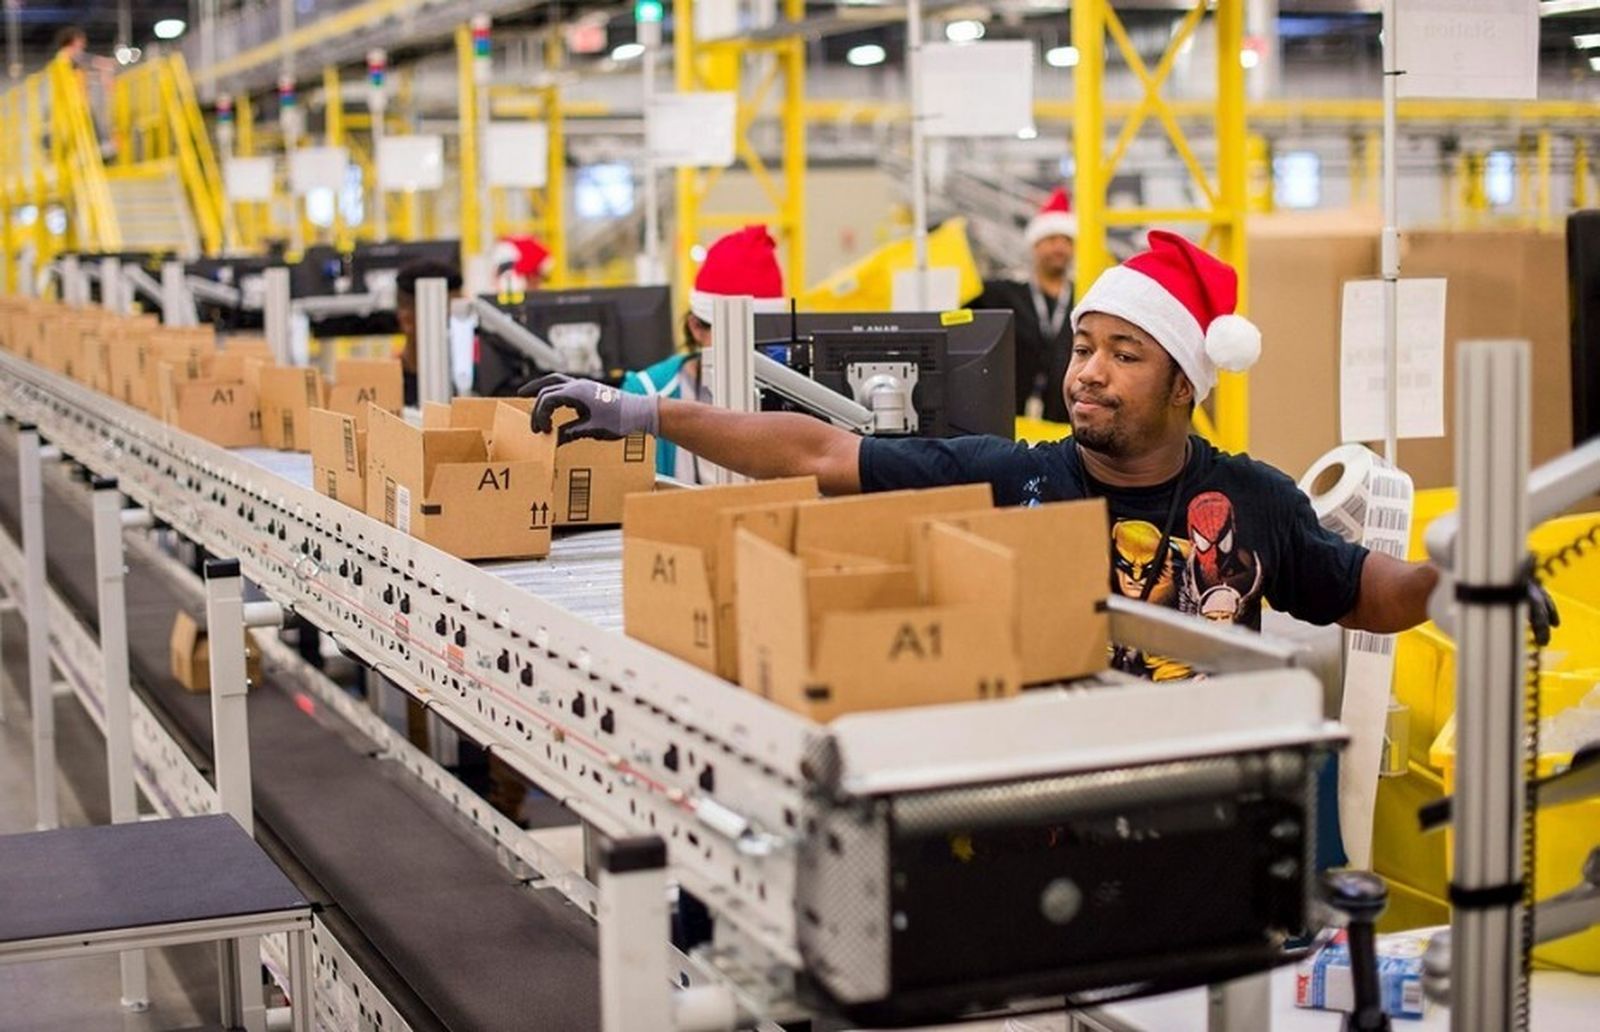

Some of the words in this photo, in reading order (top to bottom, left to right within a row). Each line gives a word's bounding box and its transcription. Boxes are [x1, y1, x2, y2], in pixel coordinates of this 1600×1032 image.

[212, 389, 235, 403] A1
[357, 387, 377, 403] A1
[478, 467, 510, 491] A1
[651, 553, 677, 585] A1
[888, 621, 942, 661] A1
